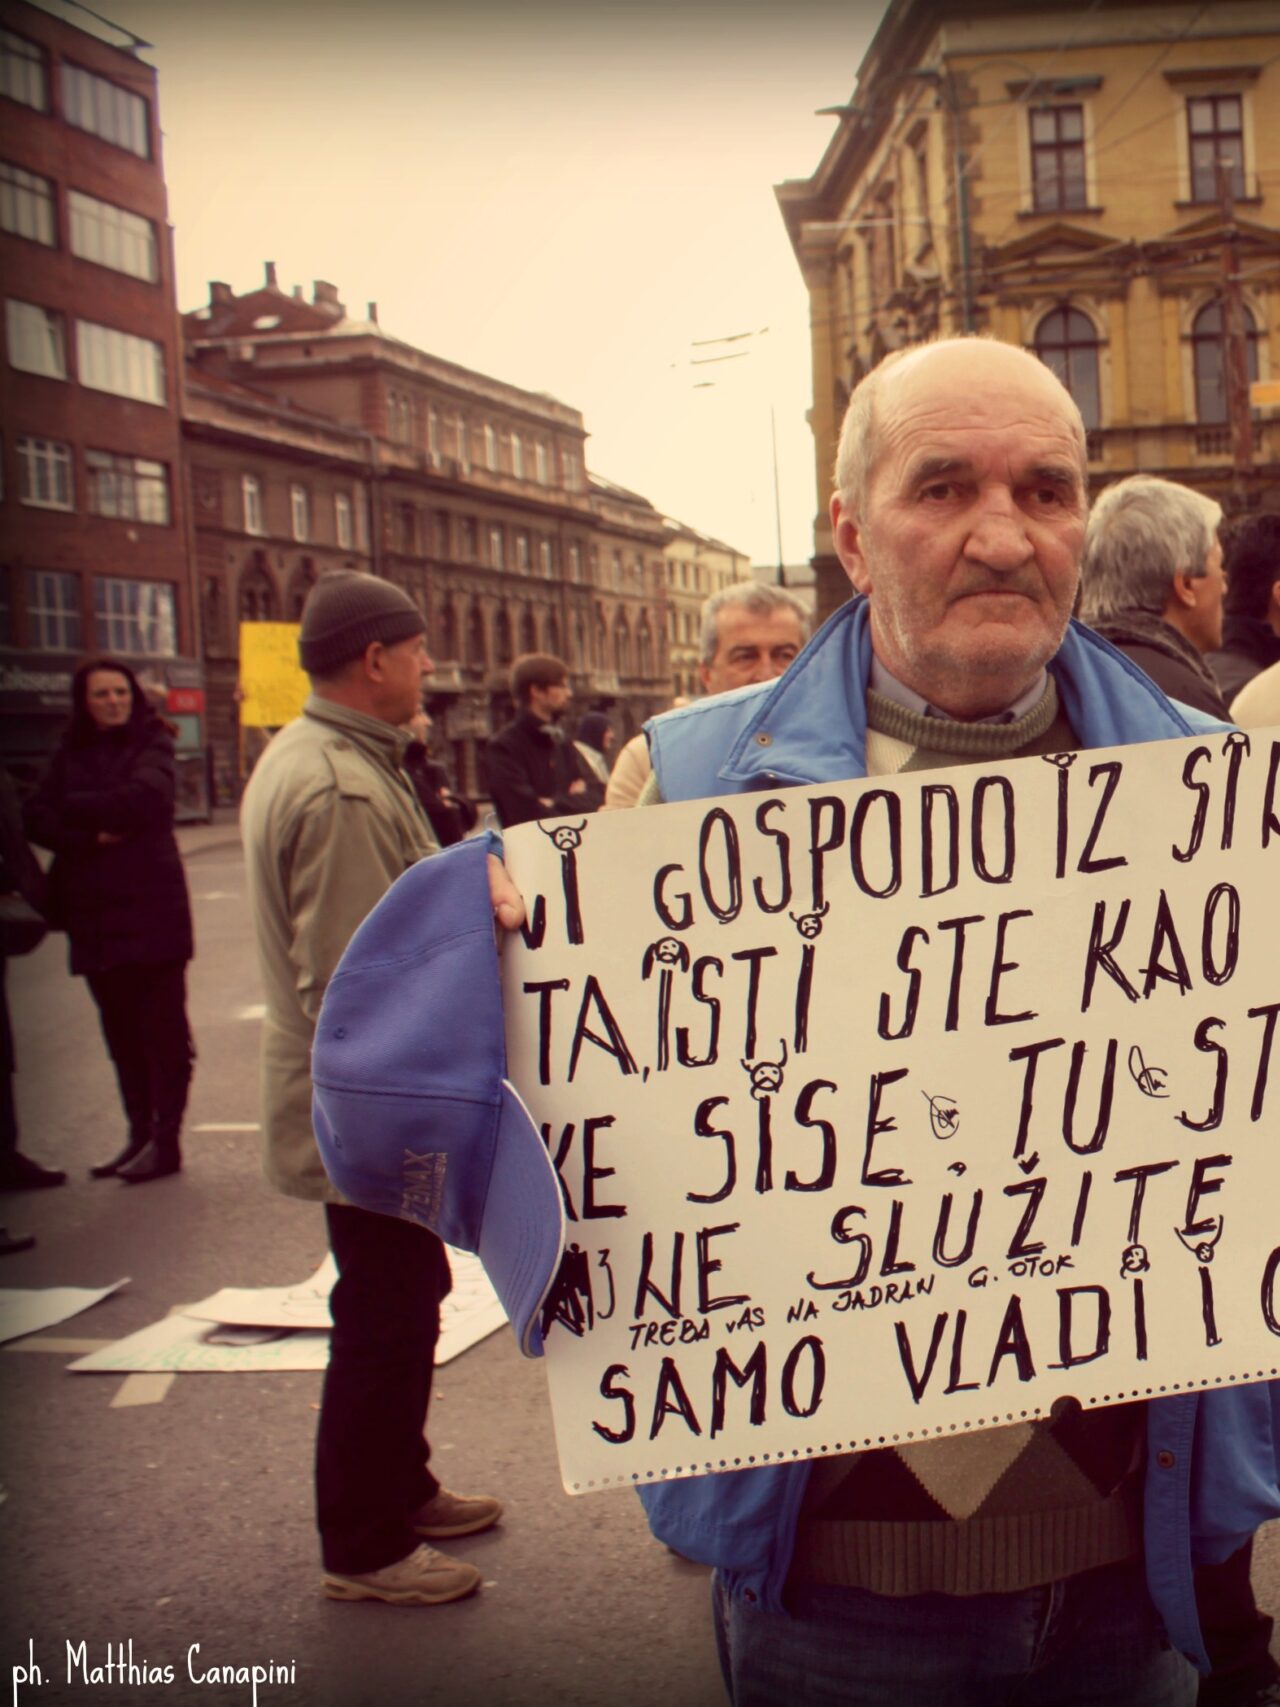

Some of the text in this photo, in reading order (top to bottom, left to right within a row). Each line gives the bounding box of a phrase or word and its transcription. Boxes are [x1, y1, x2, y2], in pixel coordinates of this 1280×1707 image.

[653, 775, 1015, 930] GOSPODO
[1050, 757, 1129, 880] IZ
[877, 909, 1039, 1040] STE
[1081, 882, 1239, 1012] KAO
[541, 1115, 628, 1222] KE
[1009, 1037, 1118, 1158] TU
[629, 1318, 710, 1350] TREBA
[788, 1298, 819, 1324] NA
[833, 1274, 934, 1312] JADRAN
[1008, 1254, 1075, 1278] OTOK
[634, 1222, 751, 1319] NE
[807, 1152, 1233, 1291] SLUŽITE
[592, 1335, 826, 1444] SAMO
[895, 1272, 1148, 1404] VLADI
